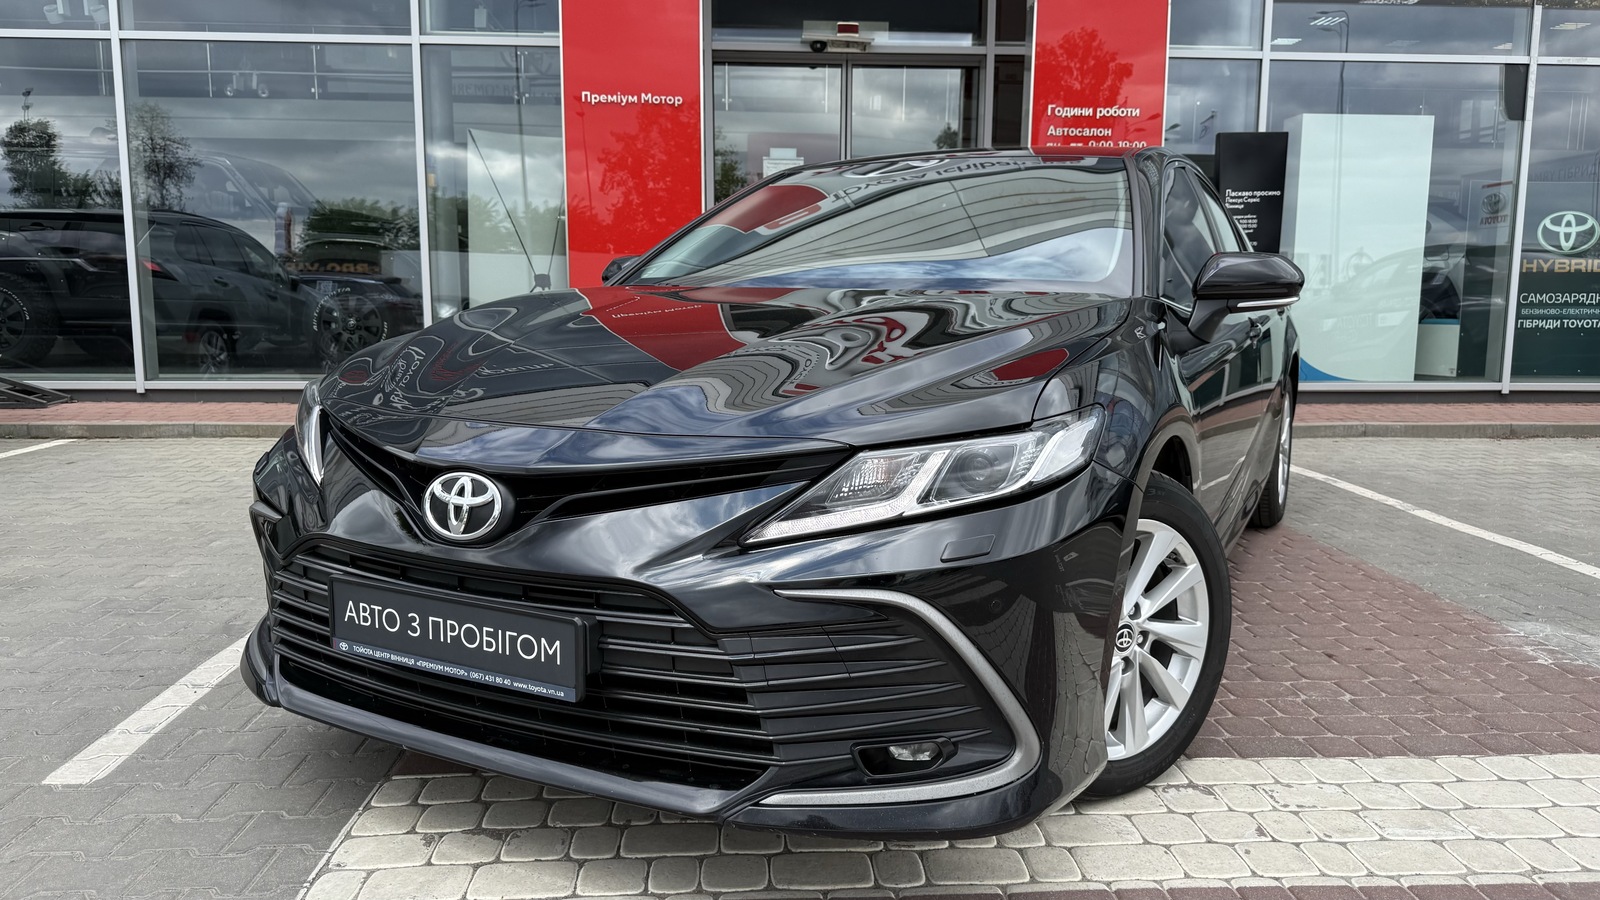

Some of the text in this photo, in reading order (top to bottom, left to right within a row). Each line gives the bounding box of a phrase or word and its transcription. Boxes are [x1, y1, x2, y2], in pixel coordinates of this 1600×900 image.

[581, 90, 683, 107] Преміум Мотор
[1047, 104, 1140, 120] Години роботи
[1047, 125, 1112, 137] Автосалон
[1518, 319, 1560, 329] ГІБРИДИ
[344, 600, 561, 666] АВТО З ПРОБІГОМ
[353, 645, 374, 656] ТОЙОТА
[373, 650, 390, 659] ЦЕНТР
[390, 654, 415, 665] ВІННИЦЯ
[469, 671, 485, 681] (067)
[485, 674, 495, 682] 431
[503, 678, 511, 686] 40
[512, 681, 565, 697] www.toyota.vn.ua
